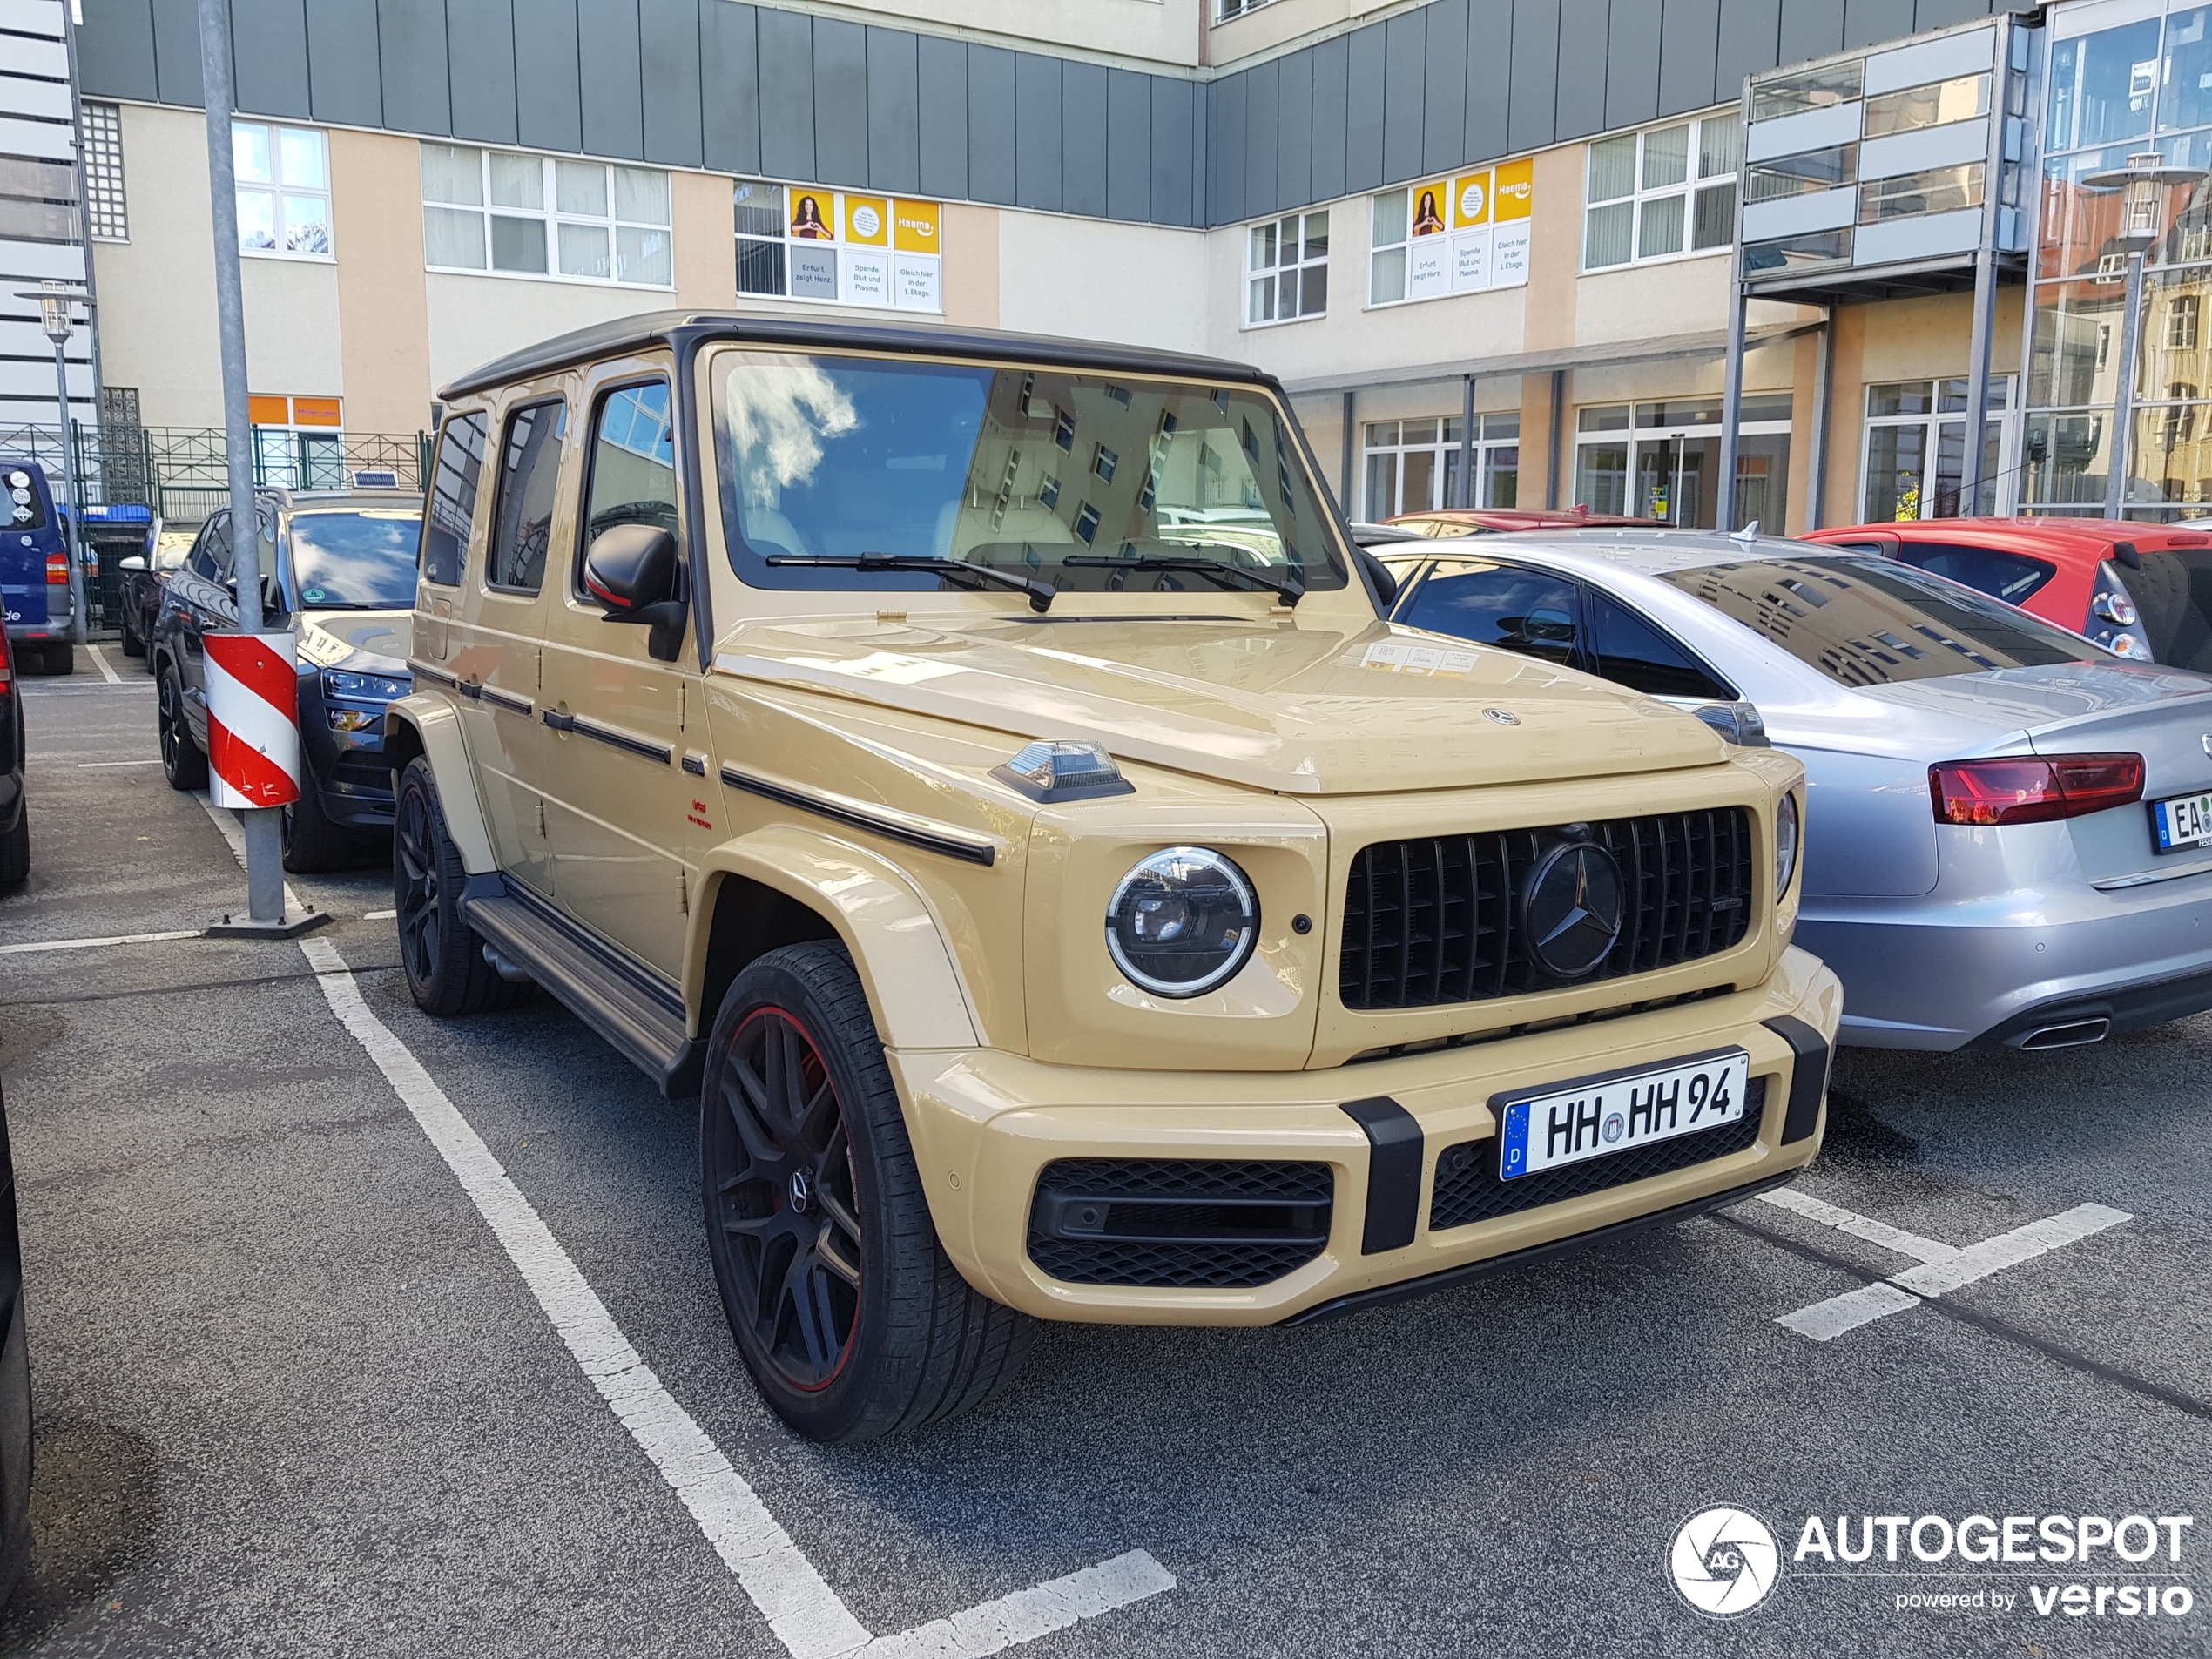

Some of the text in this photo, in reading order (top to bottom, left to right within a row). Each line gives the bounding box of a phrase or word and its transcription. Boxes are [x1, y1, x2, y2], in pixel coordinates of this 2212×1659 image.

[1498, 240, 1515, 249] Gleich
[1460, 247, 1480, 257] Spende
[802, 264, 825, 273] Erfurt
[854, 264, 880, 273] Spende
[1419, 260, 1436, 270] Erfurt
[1413, 272, 1426, 280] zeigt
[855, 283, 880, 293] Plasma.
[911, 289, 931, 298] Etage.
[2175, 802, 2202, 838] EA
[1547, 1066, 1730, 1159] HH HH 94
[1510, 1148, 1521, 1164] D
